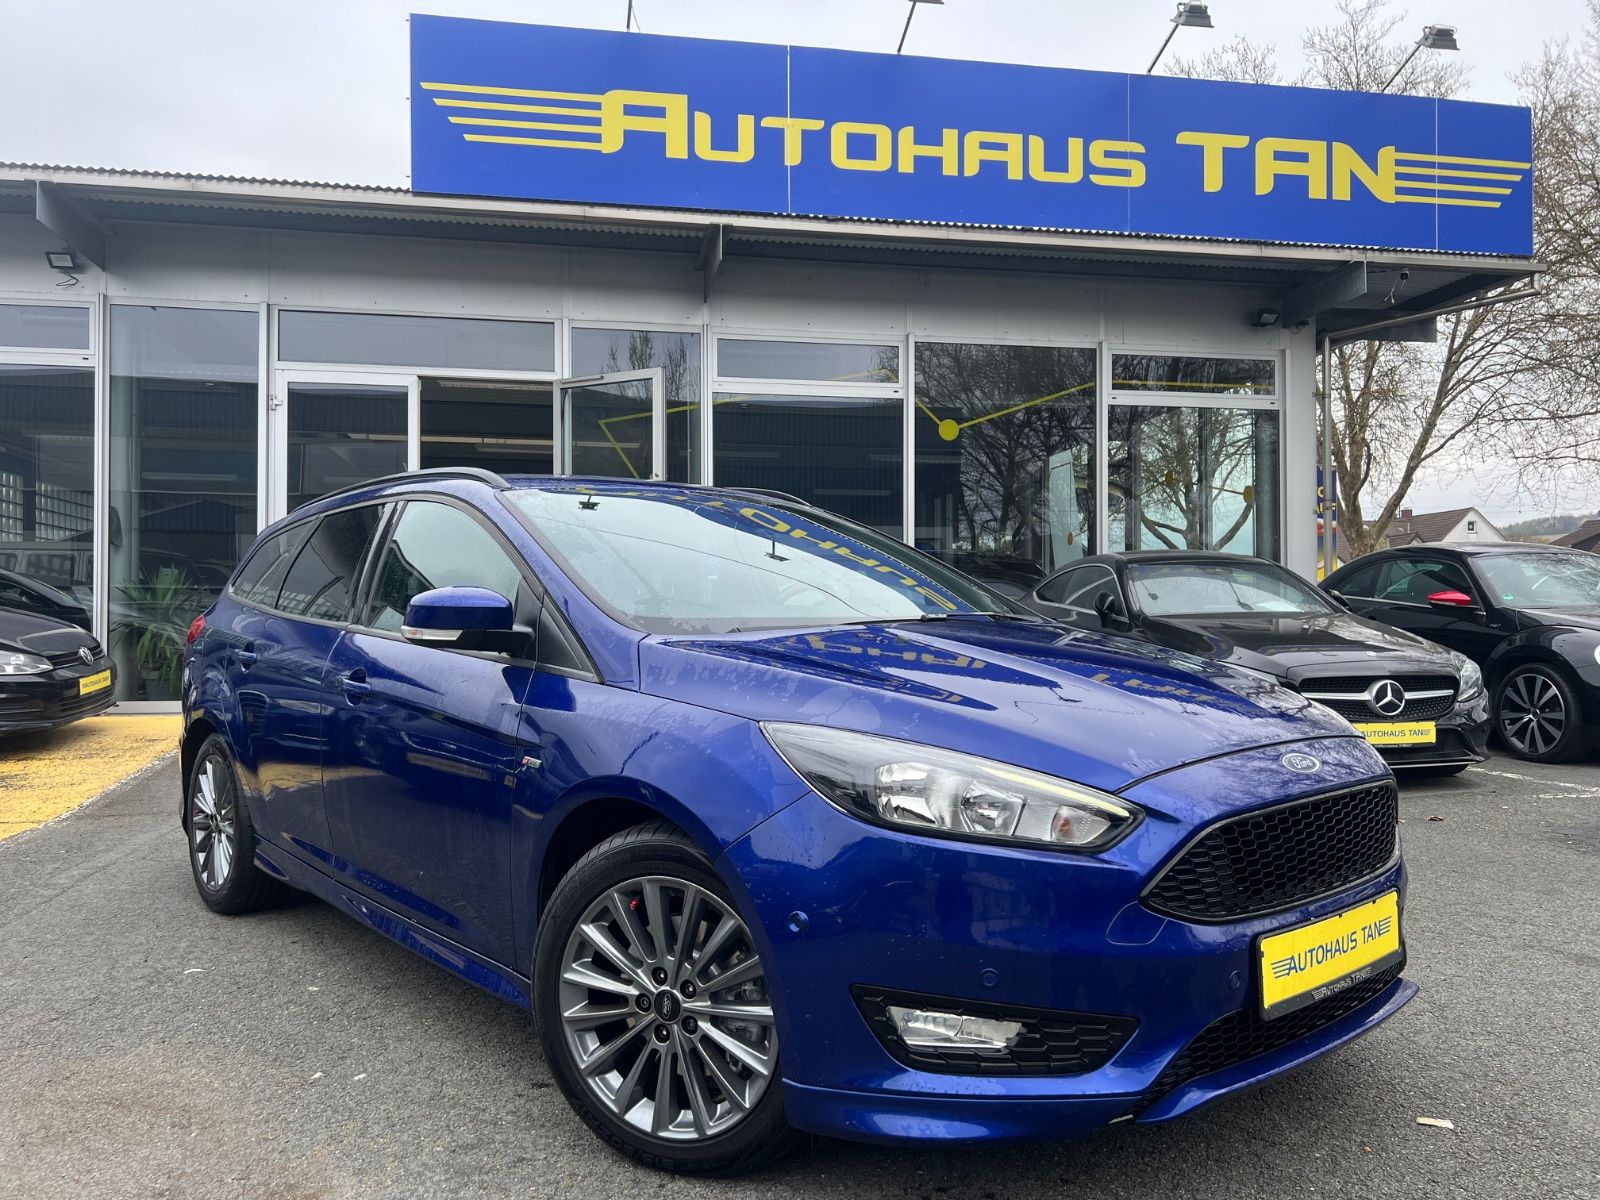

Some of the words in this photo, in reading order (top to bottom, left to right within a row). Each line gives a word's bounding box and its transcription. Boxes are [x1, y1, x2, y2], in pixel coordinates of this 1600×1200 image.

[601, 89, 1146, 188] AUTOHAUS
[1176, 131, 1396, 204] TAN
[1361, 729, 1406, 738] AUTOHAUS
[1408, 729, 1423, 737] TAN
[1286, 931, 1358, 976] AUTOHAUS
[1361, 920, 1382, 945] TAN
